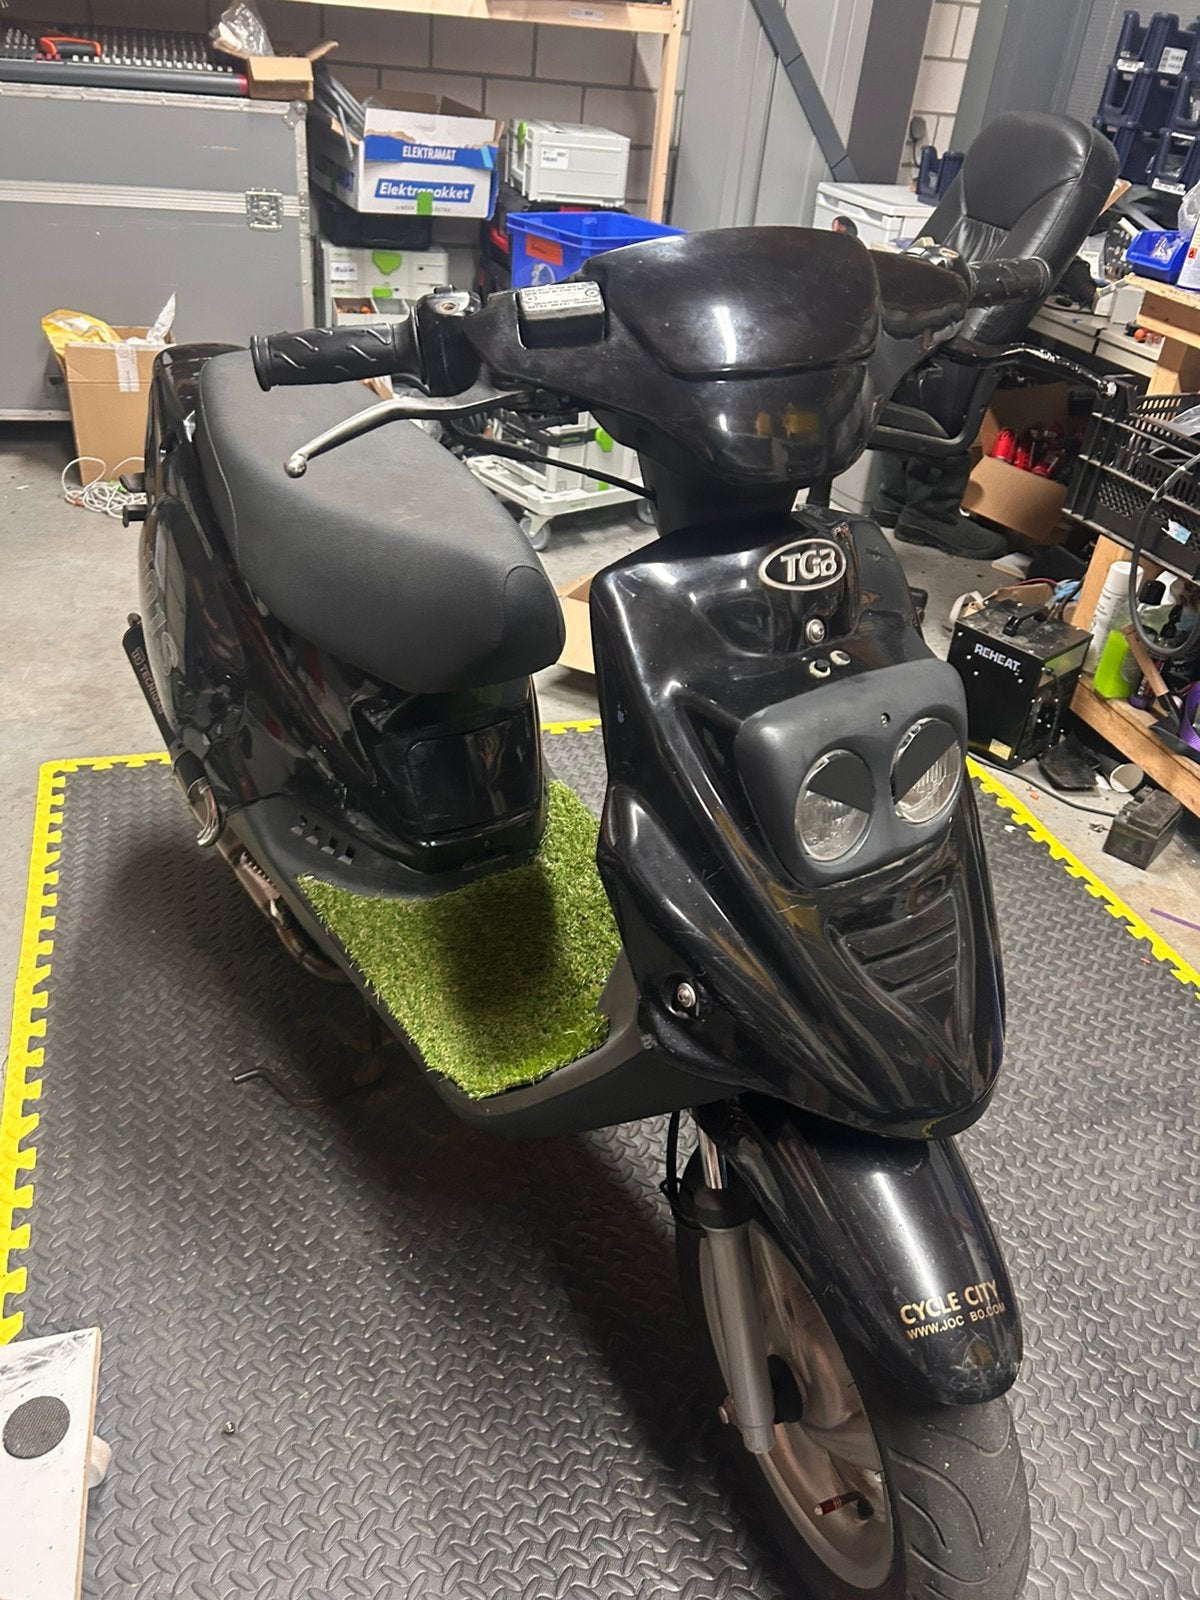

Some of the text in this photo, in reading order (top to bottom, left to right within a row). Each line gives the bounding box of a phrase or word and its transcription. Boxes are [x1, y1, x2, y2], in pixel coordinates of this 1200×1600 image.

[402, 145, 457, 161] ELEKTRAMAT
[780, 548, 838, 583] TGB
[900, 1280, 998, 1324] CYCLE CITY
